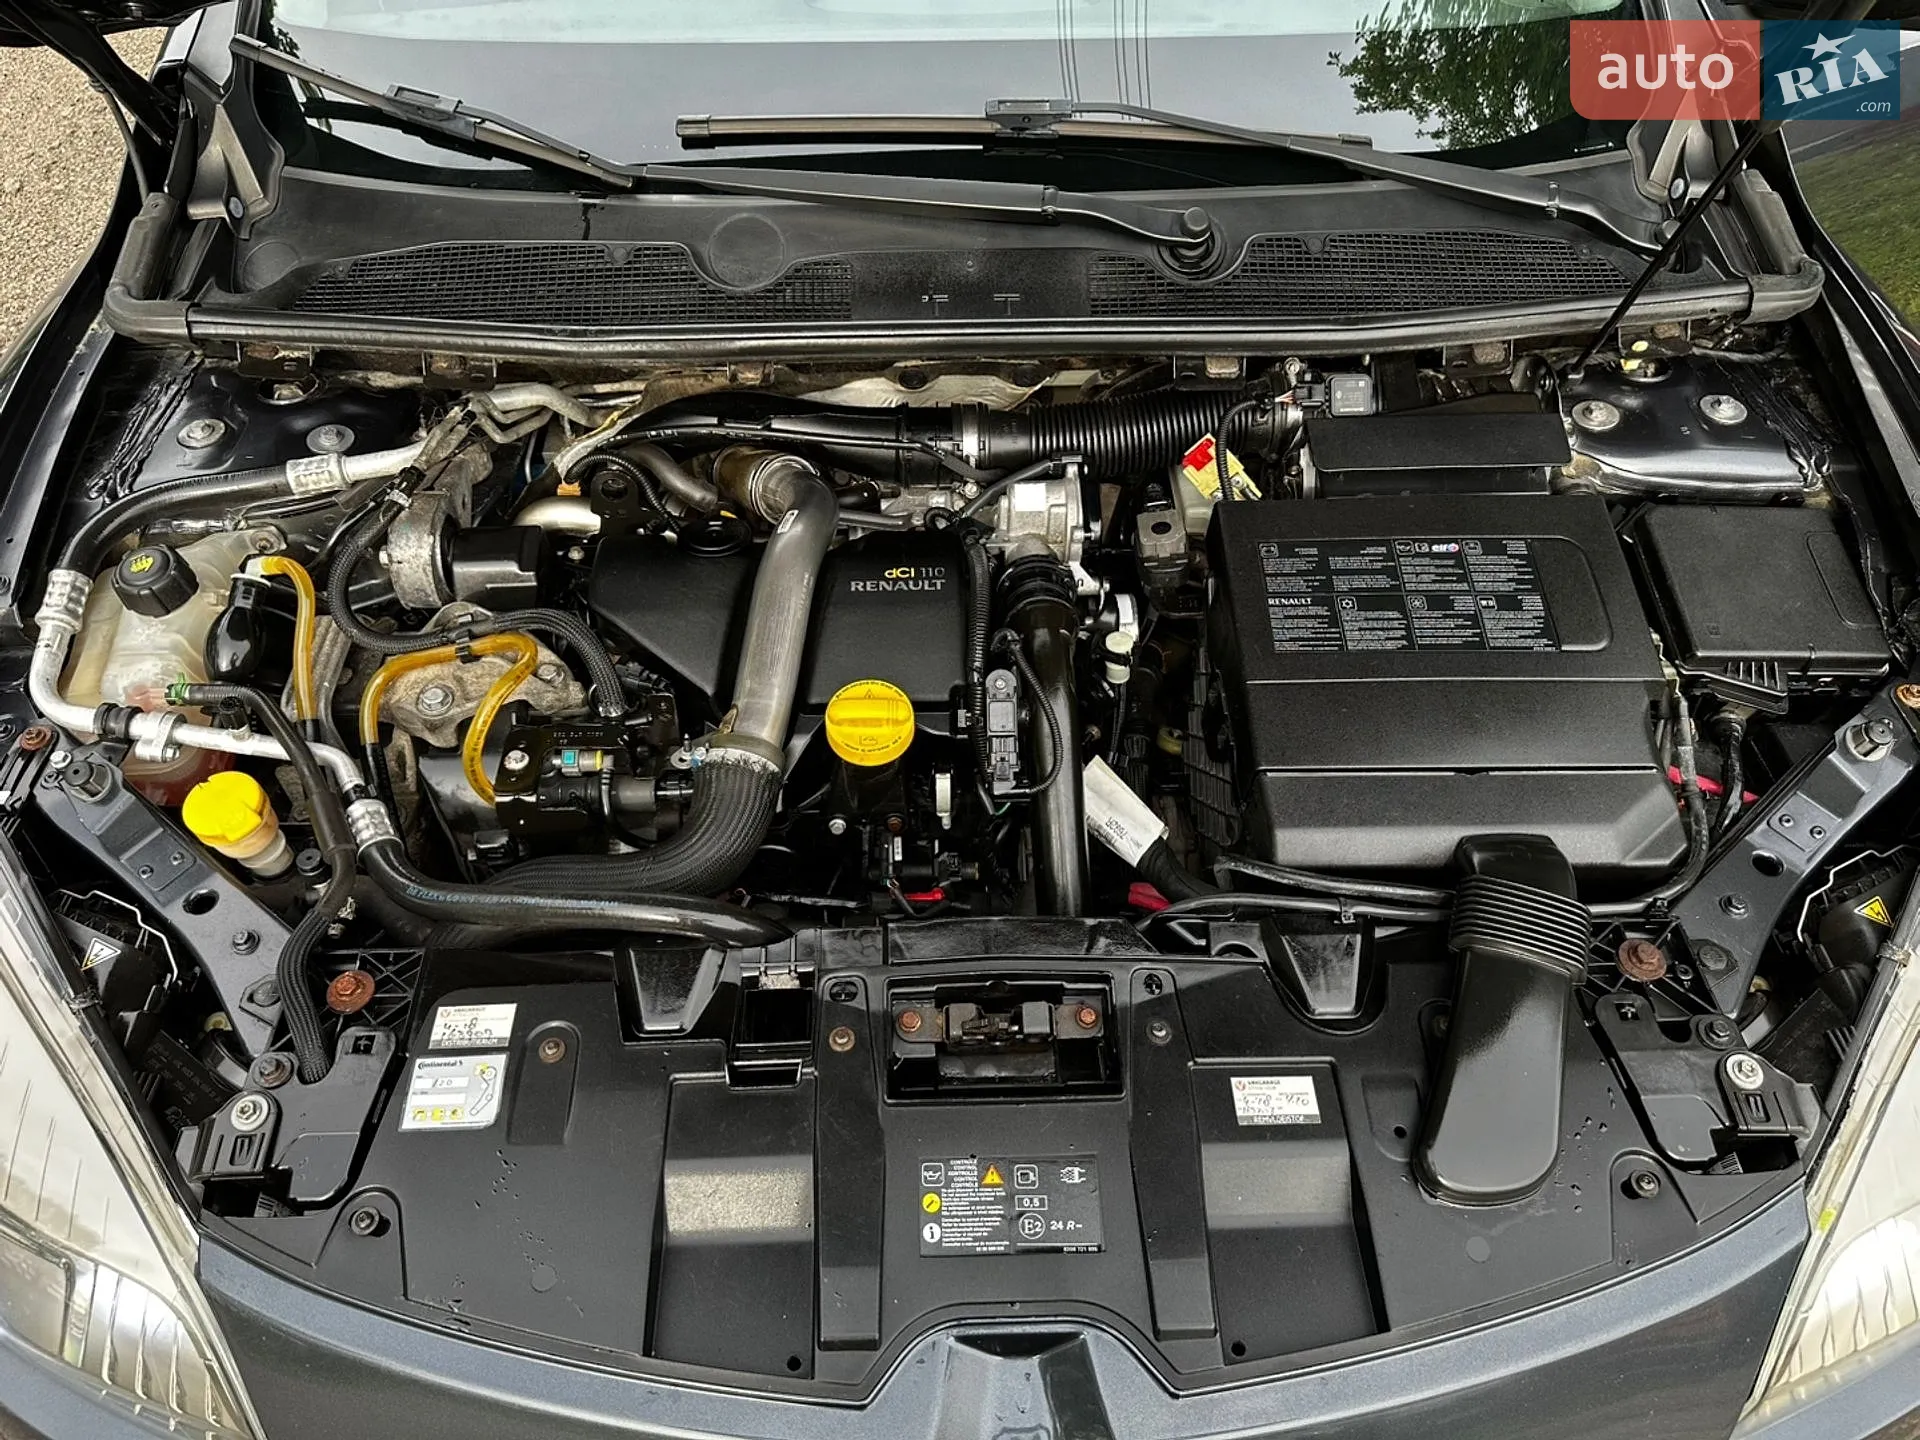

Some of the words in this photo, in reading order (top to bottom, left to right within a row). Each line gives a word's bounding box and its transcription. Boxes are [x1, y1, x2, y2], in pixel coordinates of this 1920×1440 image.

[920, 567, 945, 578] 110
[850, 579, 946, 592] RENAULT
[1267, 597, 1312, 605] RENAULT
[418, 1060, 457, 1069] Continental
[1023, 1218, 1042, 1234] E2
[1050, 1220, 1064, 1231] 24
